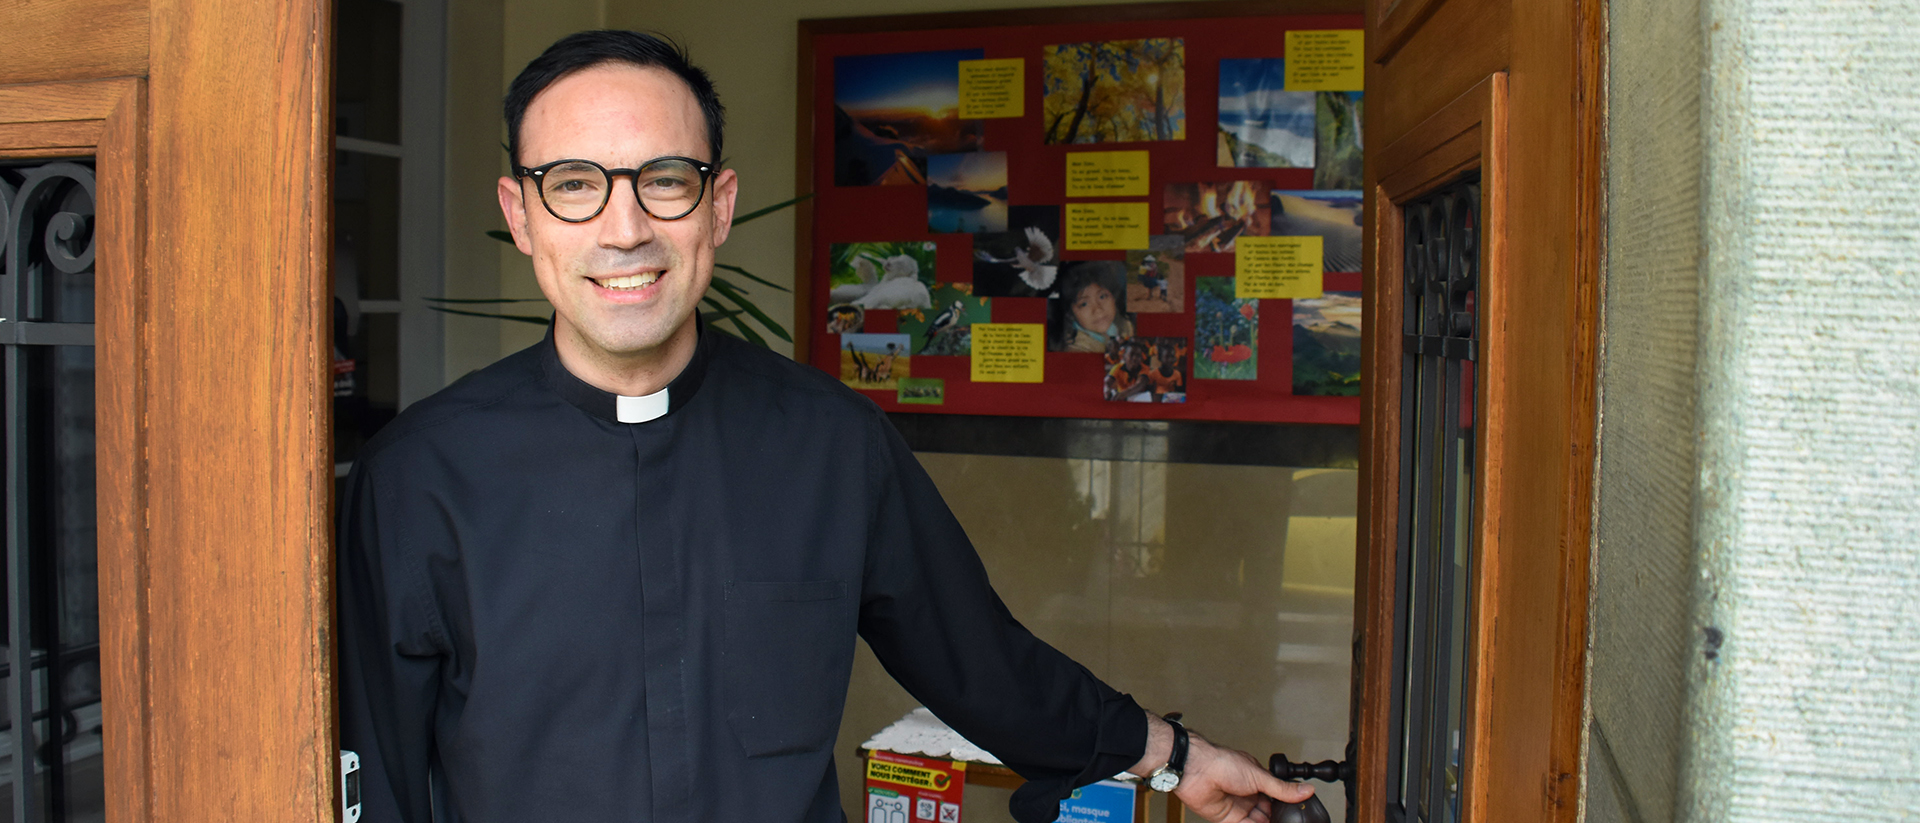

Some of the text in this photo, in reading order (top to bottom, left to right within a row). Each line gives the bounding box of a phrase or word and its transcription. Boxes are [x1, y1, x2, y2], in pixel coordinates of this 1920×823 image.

[870, 770, 890, 780] NOUS
[871, 762, 930, 778] VOICI COMMENT
[1071, 806, 1109, 817] masque
